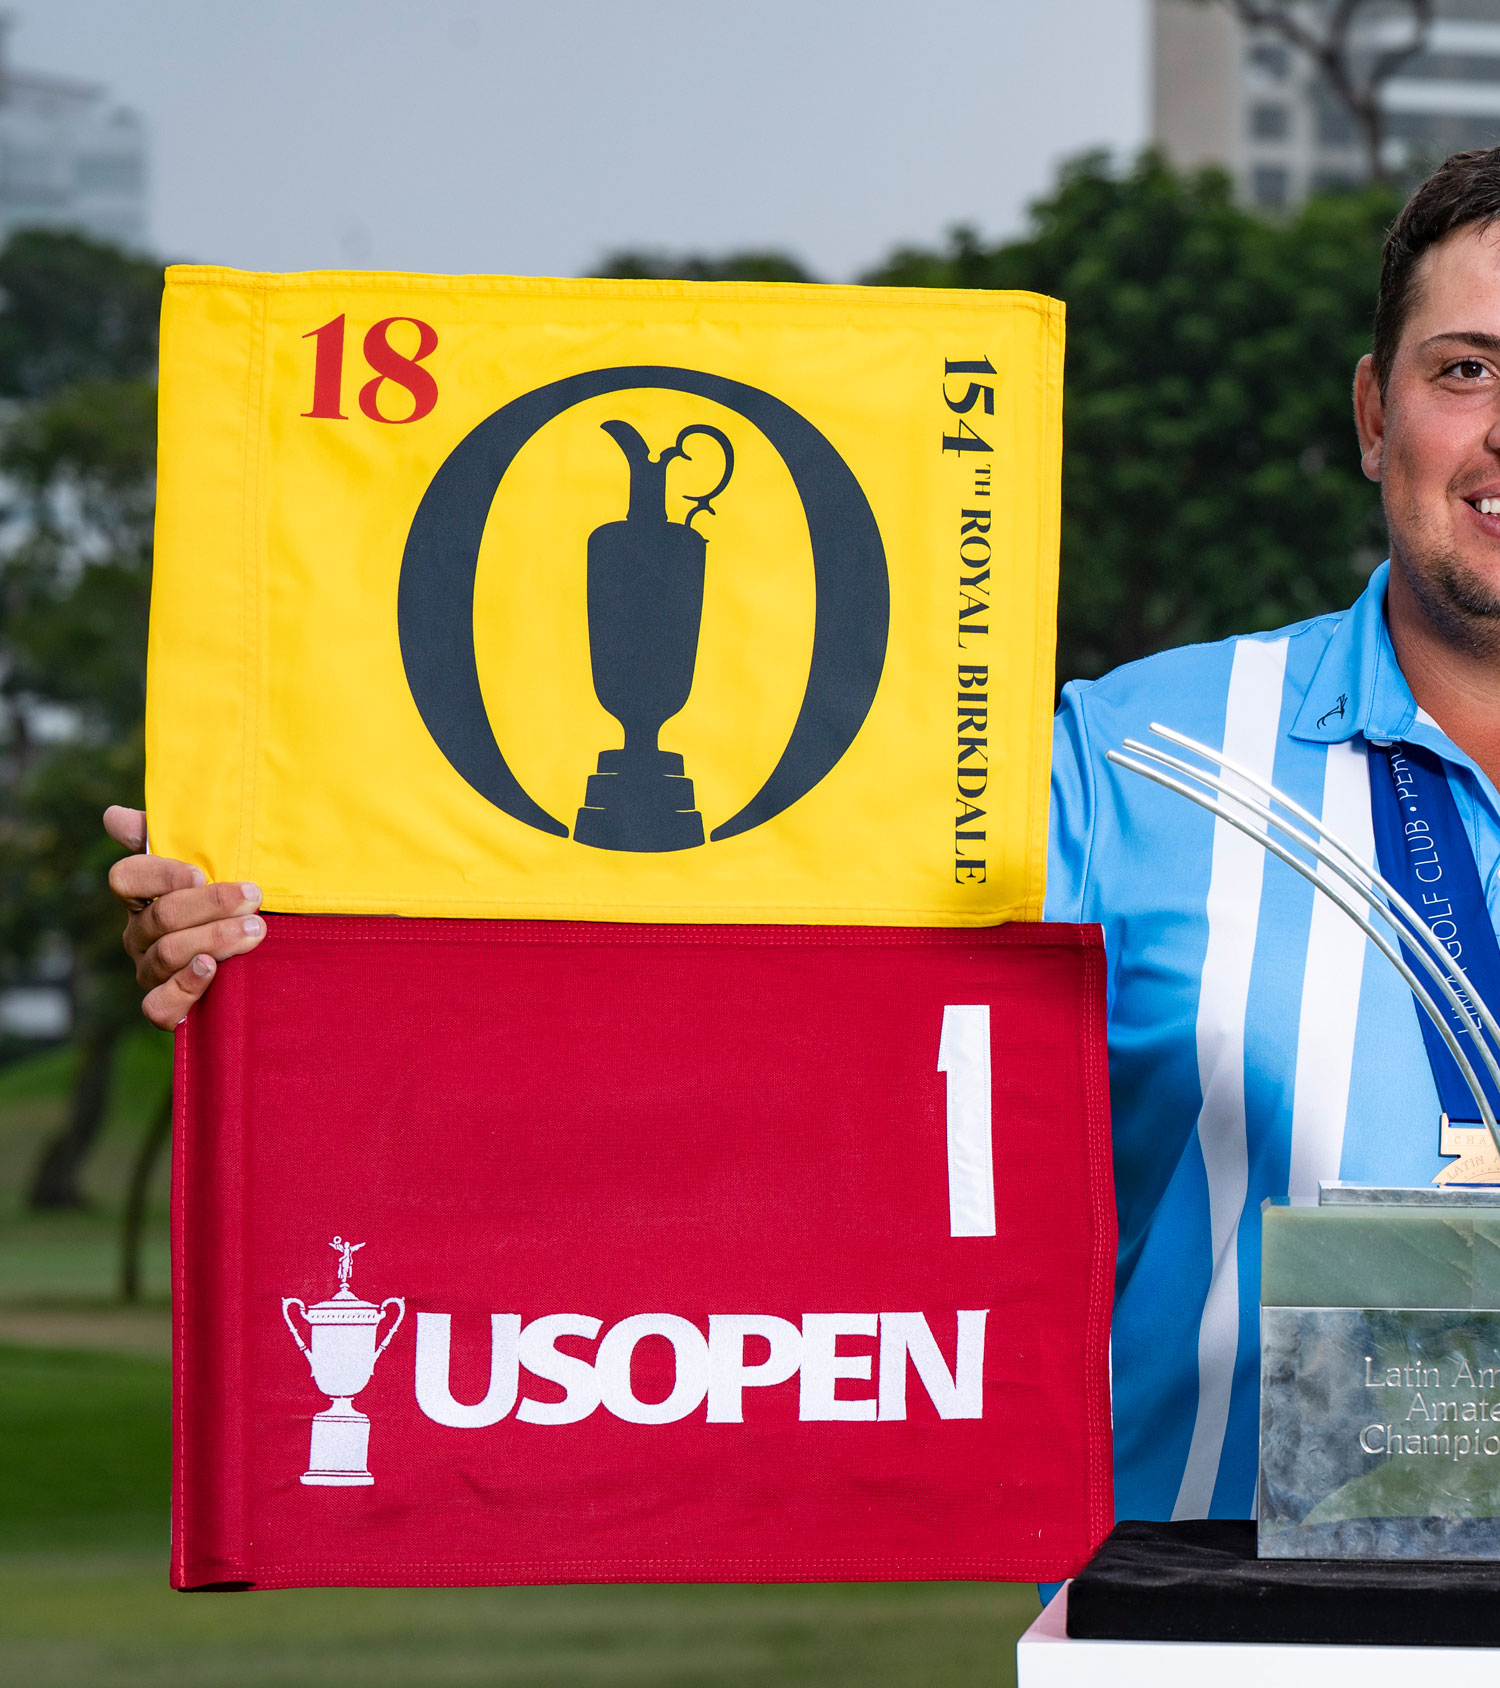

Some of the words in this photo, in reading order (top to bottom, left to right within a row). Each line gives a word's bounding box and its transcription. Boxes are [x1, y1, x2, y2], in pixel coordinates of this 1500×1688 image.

[301, 314, 439, 424] 18
[958, 508, 992, 649] ROYAL
[955, 664, 989, 885] BIRKDALE
[1404, 819, 1443, 883] CLUB
[1422, 892, 1463, 960] GOLF
[936, 1004, 997, 1238] 1
[1364, 1356, 1441, 1388] Latin
